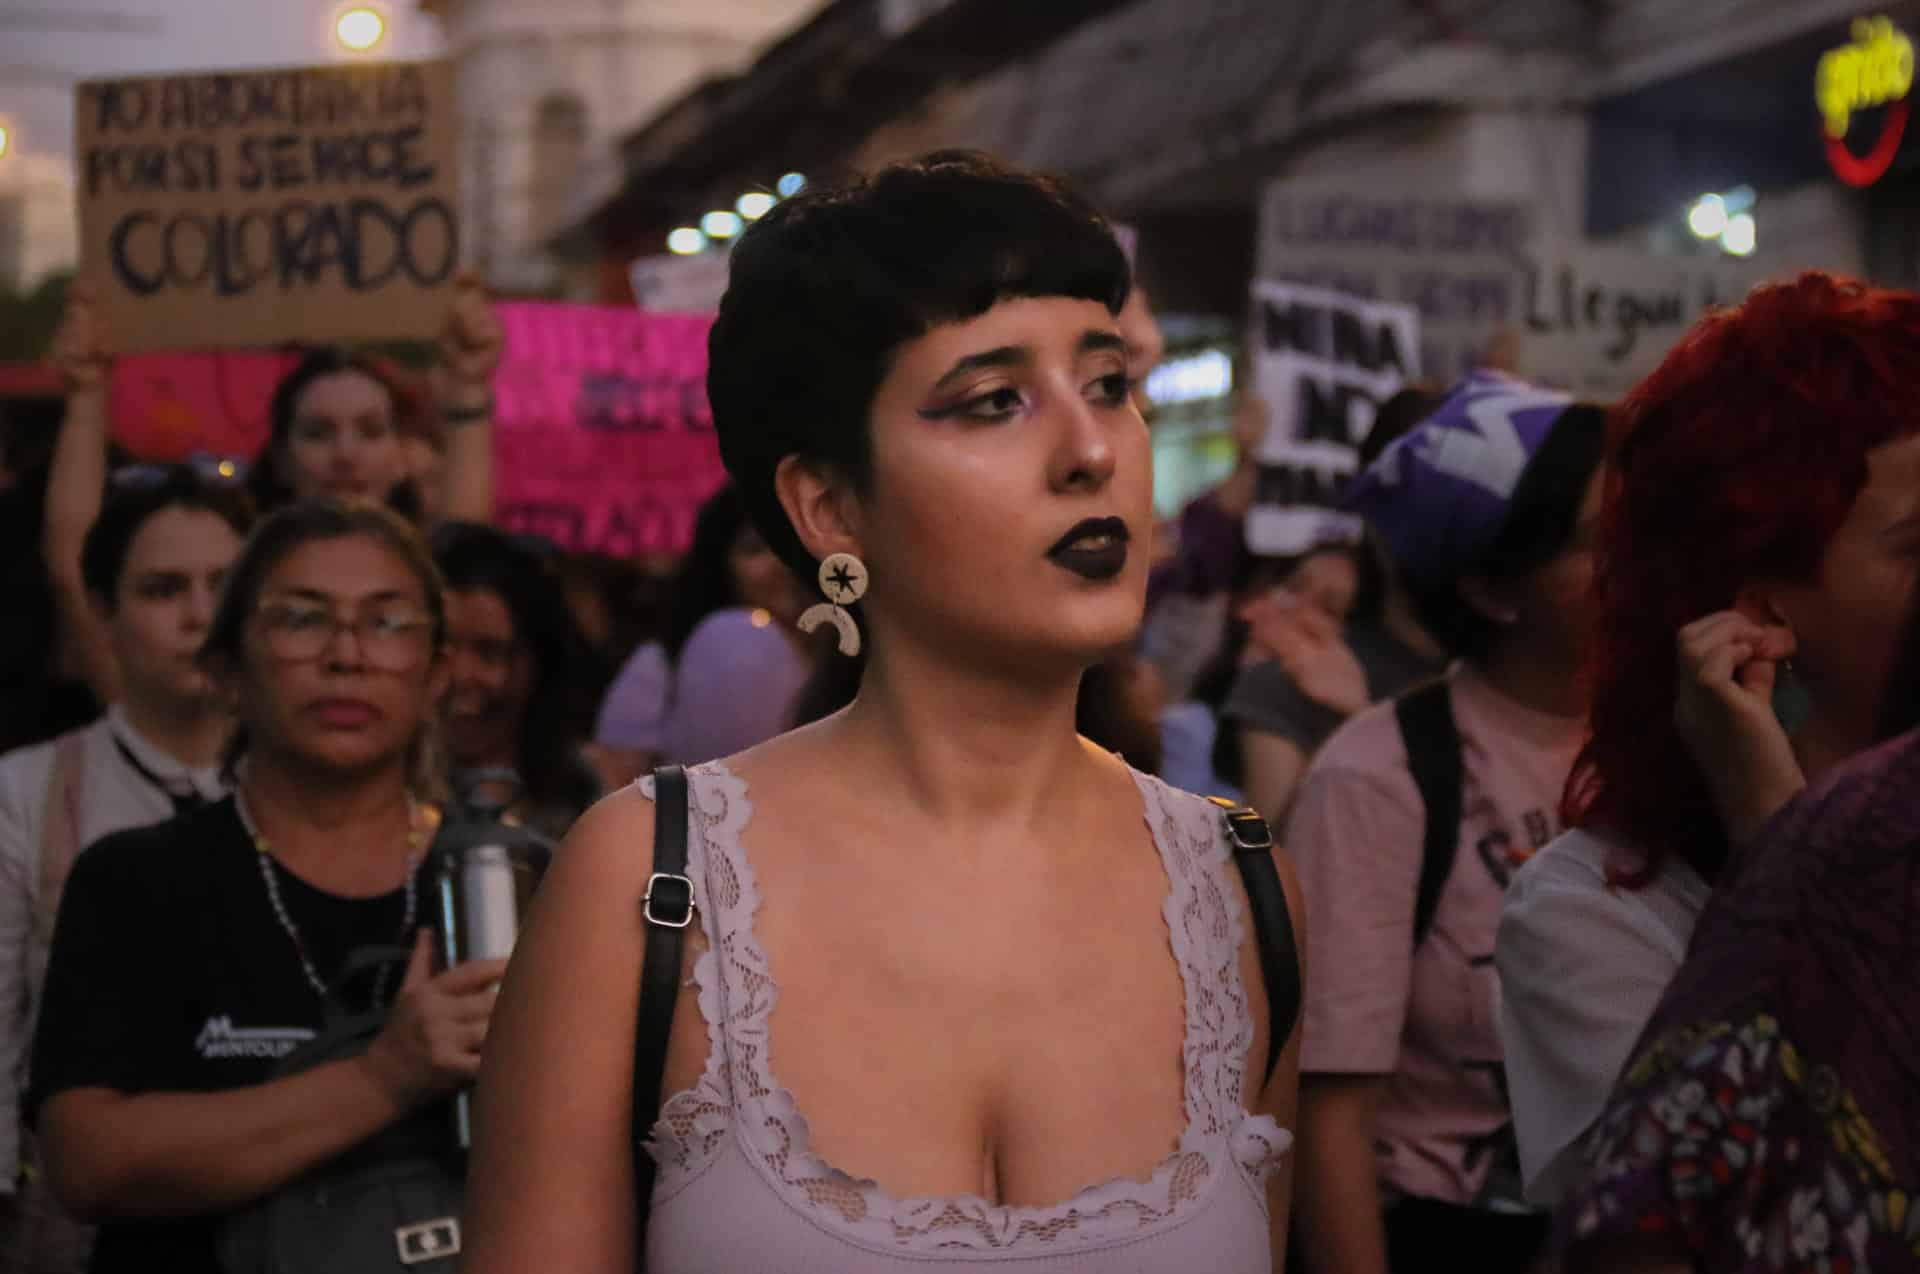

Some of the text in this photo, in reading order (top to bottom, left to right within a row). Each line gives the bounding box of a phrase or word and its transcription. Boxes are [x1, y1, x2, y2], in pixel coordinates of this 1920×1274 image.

[239, 134, 308, 190] SE
[313, 127, 436, 186] HACE
[110, 196, 460, 296] COLORADO
